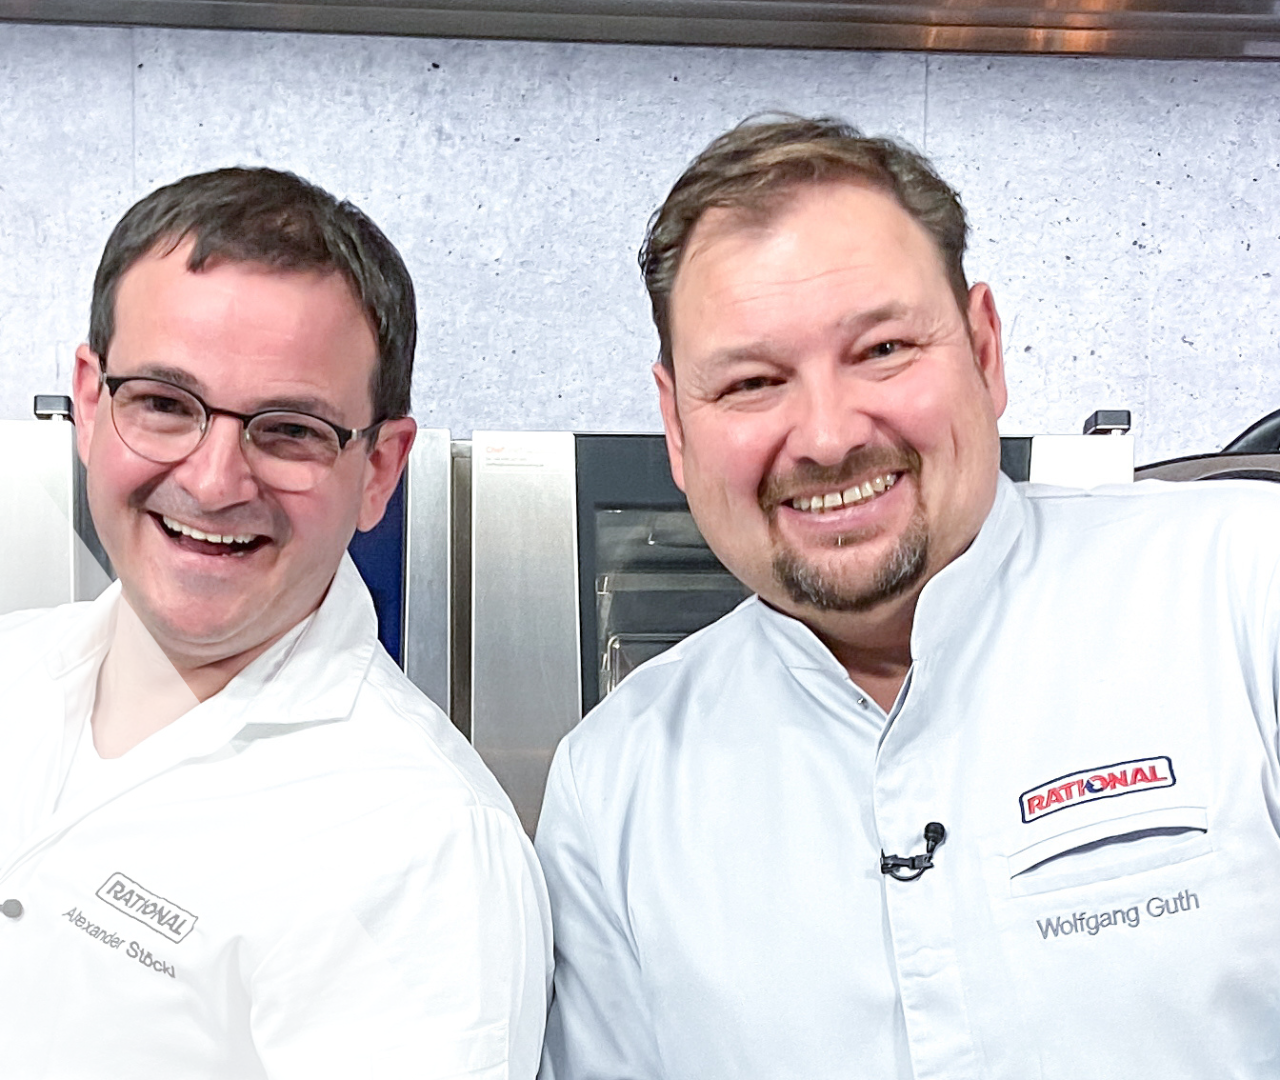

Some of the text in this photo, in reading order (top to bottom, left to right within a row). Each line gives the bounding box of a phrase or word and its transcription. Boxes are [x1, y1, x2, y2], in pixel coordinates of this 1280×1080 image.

[1027, 765, 1168, 815] RATIONAL
[61, 906, 126, 950] Alexander
[106, 879, 188, 936] RATIONAL
[1036, 889, 1201, 940] Wolfgang Guth
